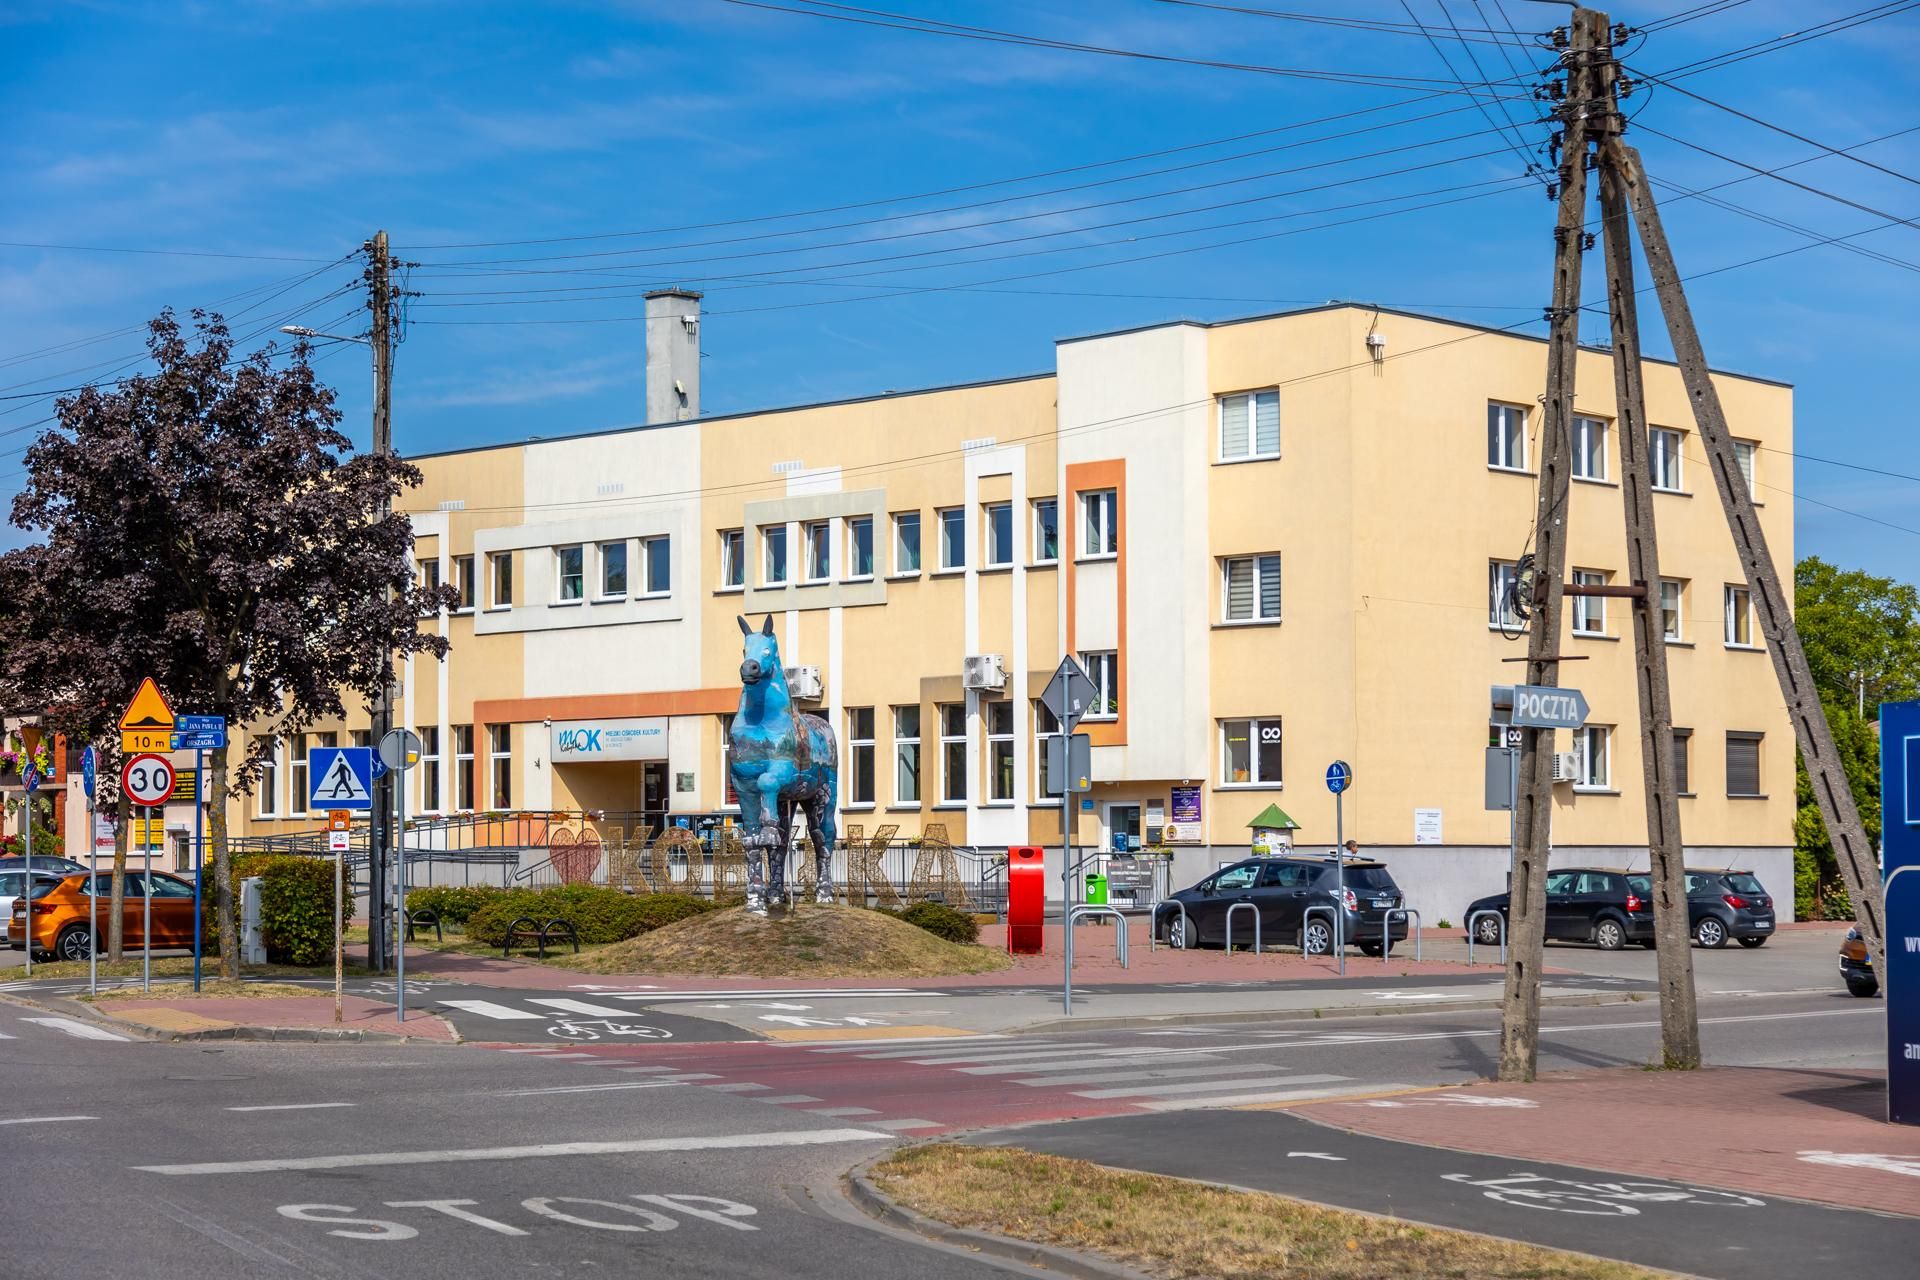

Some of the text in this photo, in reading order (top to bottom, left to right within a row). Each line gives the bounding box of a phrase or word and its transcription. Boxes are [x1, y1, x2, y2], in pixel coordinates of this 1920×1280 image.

[1518, 693, 1579, 721] POCZTA
[134, 736, 165, 748] 10 m
[559, 729, 602, 751] MOK
[130, 767, 169, 793] 30
[608, 823, 979, 912] KOBŁKA
[276, 1194, 760, 1241] STOP
